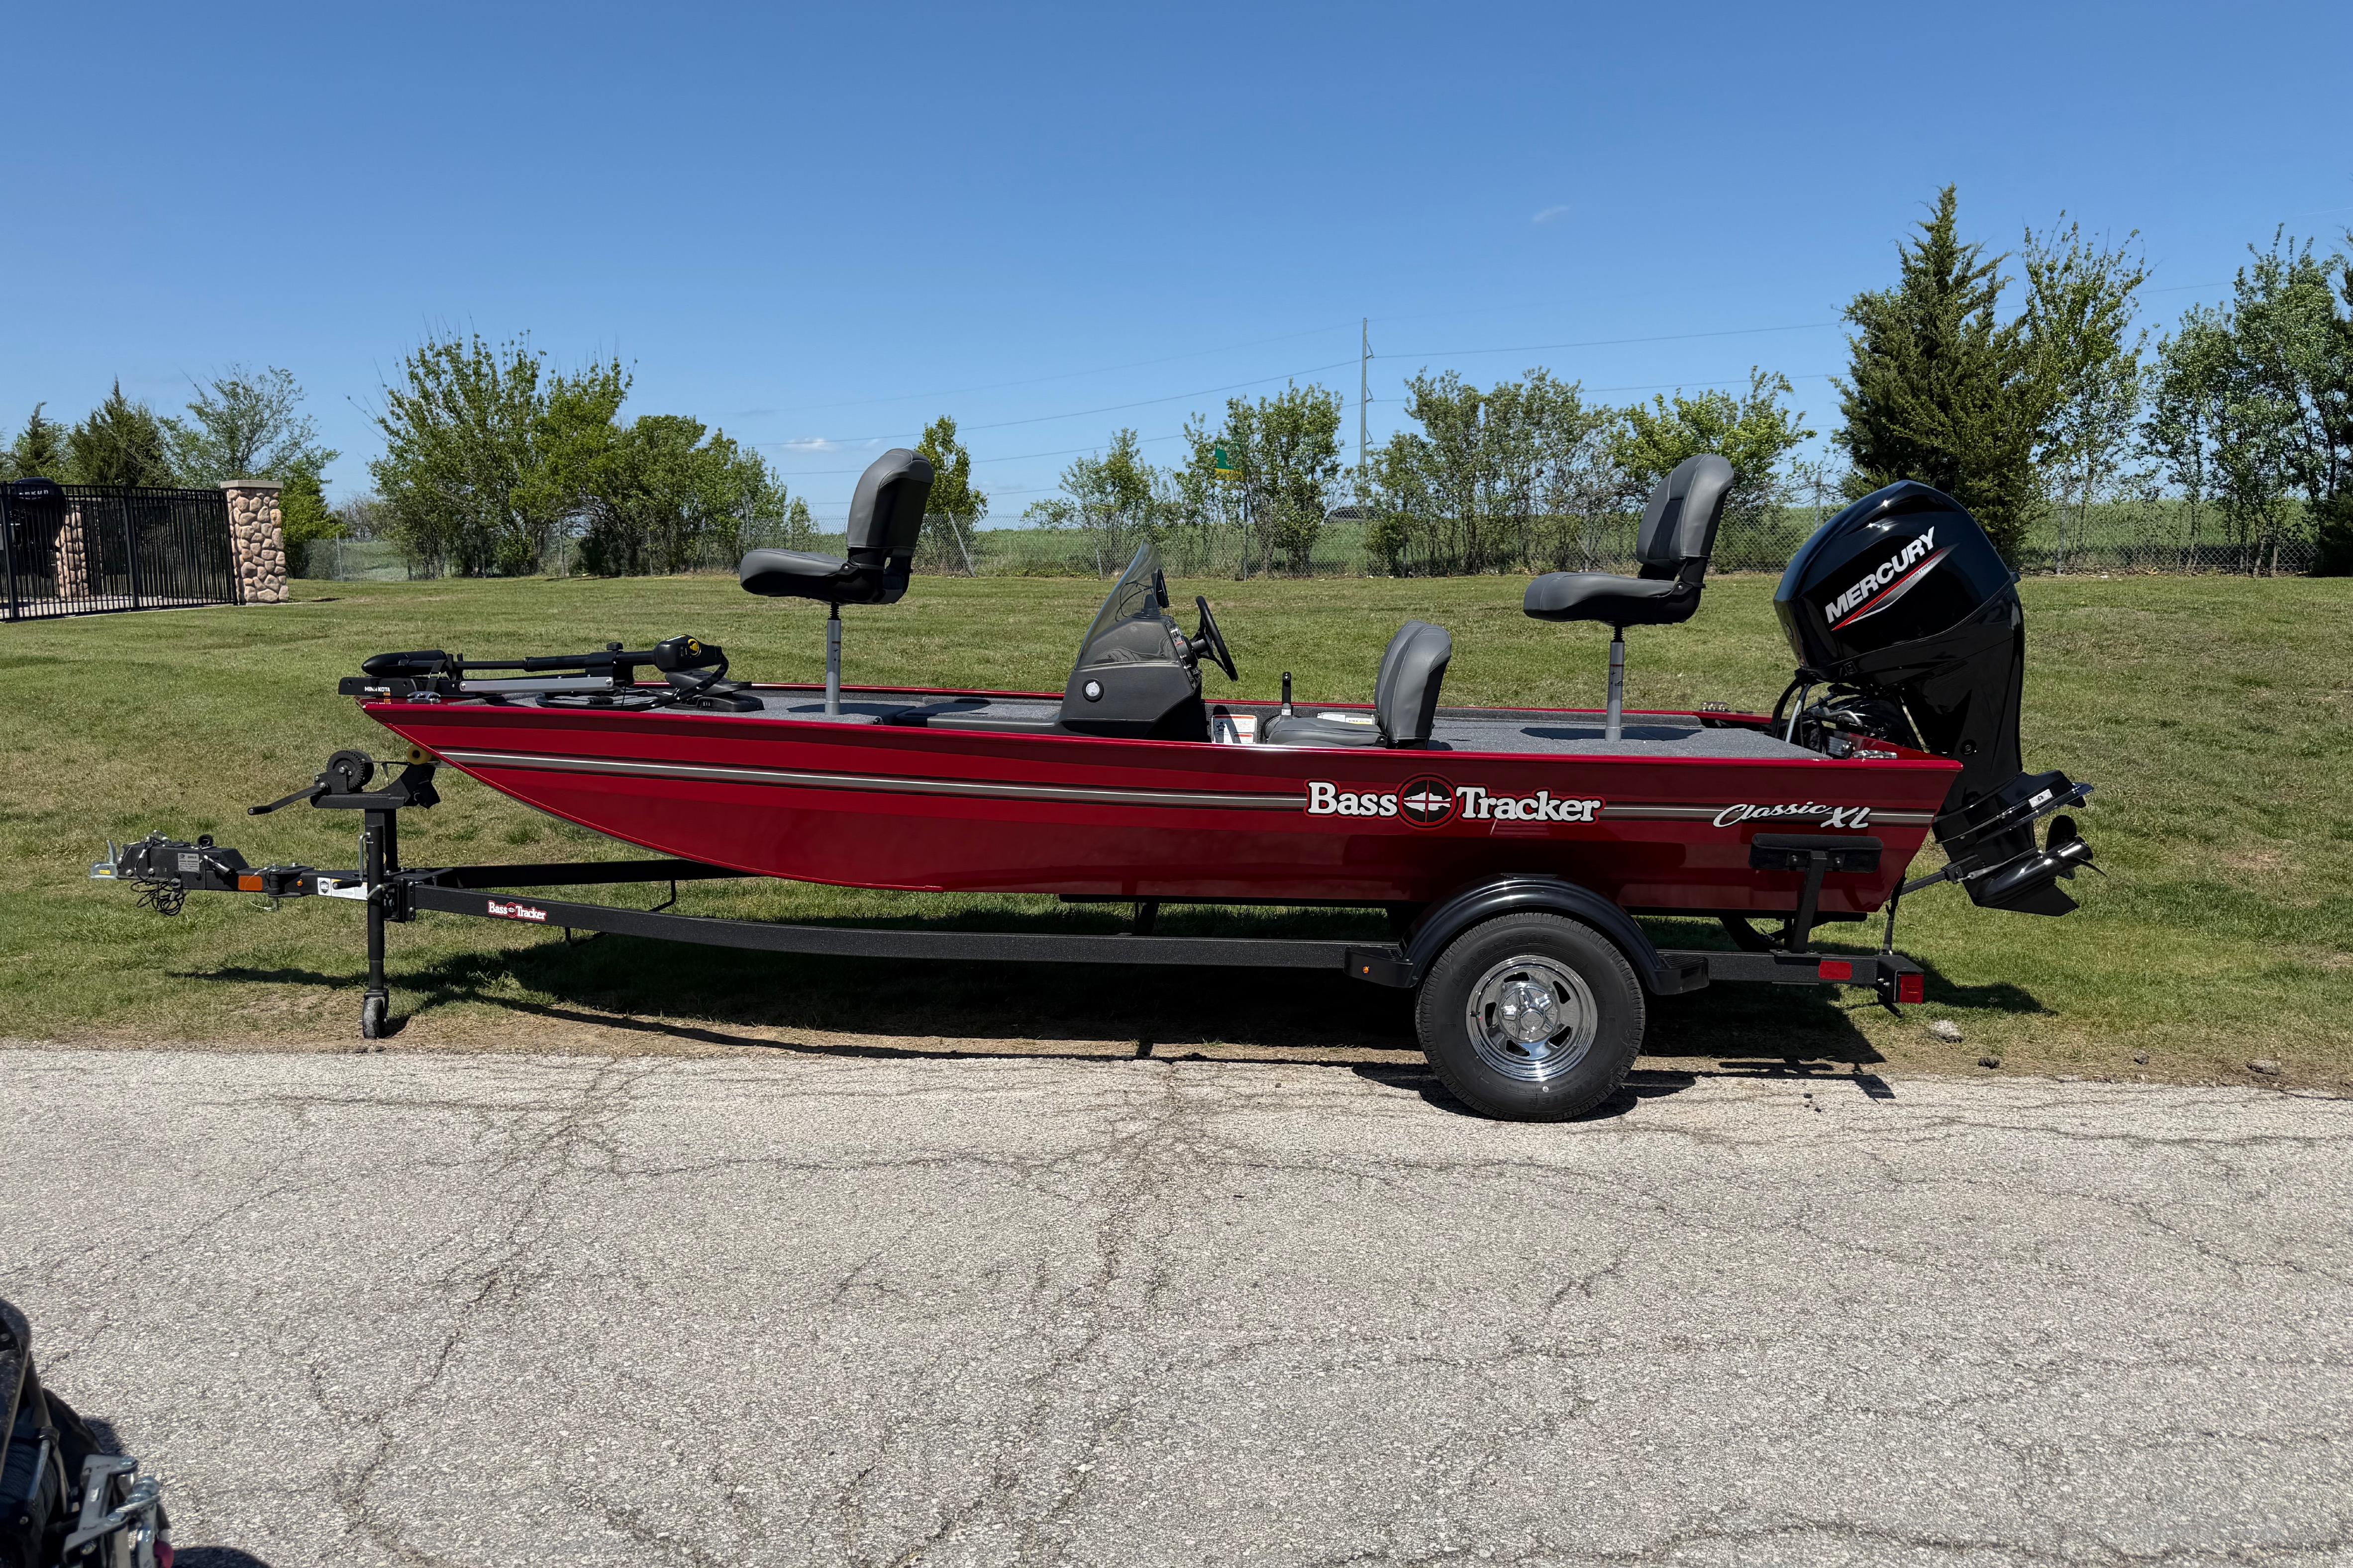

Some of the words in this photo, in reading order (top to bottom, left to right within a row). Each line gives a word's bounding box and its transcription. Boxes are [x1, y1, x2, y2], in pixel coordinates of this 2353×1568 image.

[1825, 526, 1935, 624] MERCURY
[1309, 782, 1398, 816] Bass
[1456, 786, 1600, 821] Tracker
[1713, 801, 1833, 827] Classic
[1820, 806, 1870, 829] XL
[489, 901, 508, 914] Bass
[515, 905, 546, 920] Tracker
